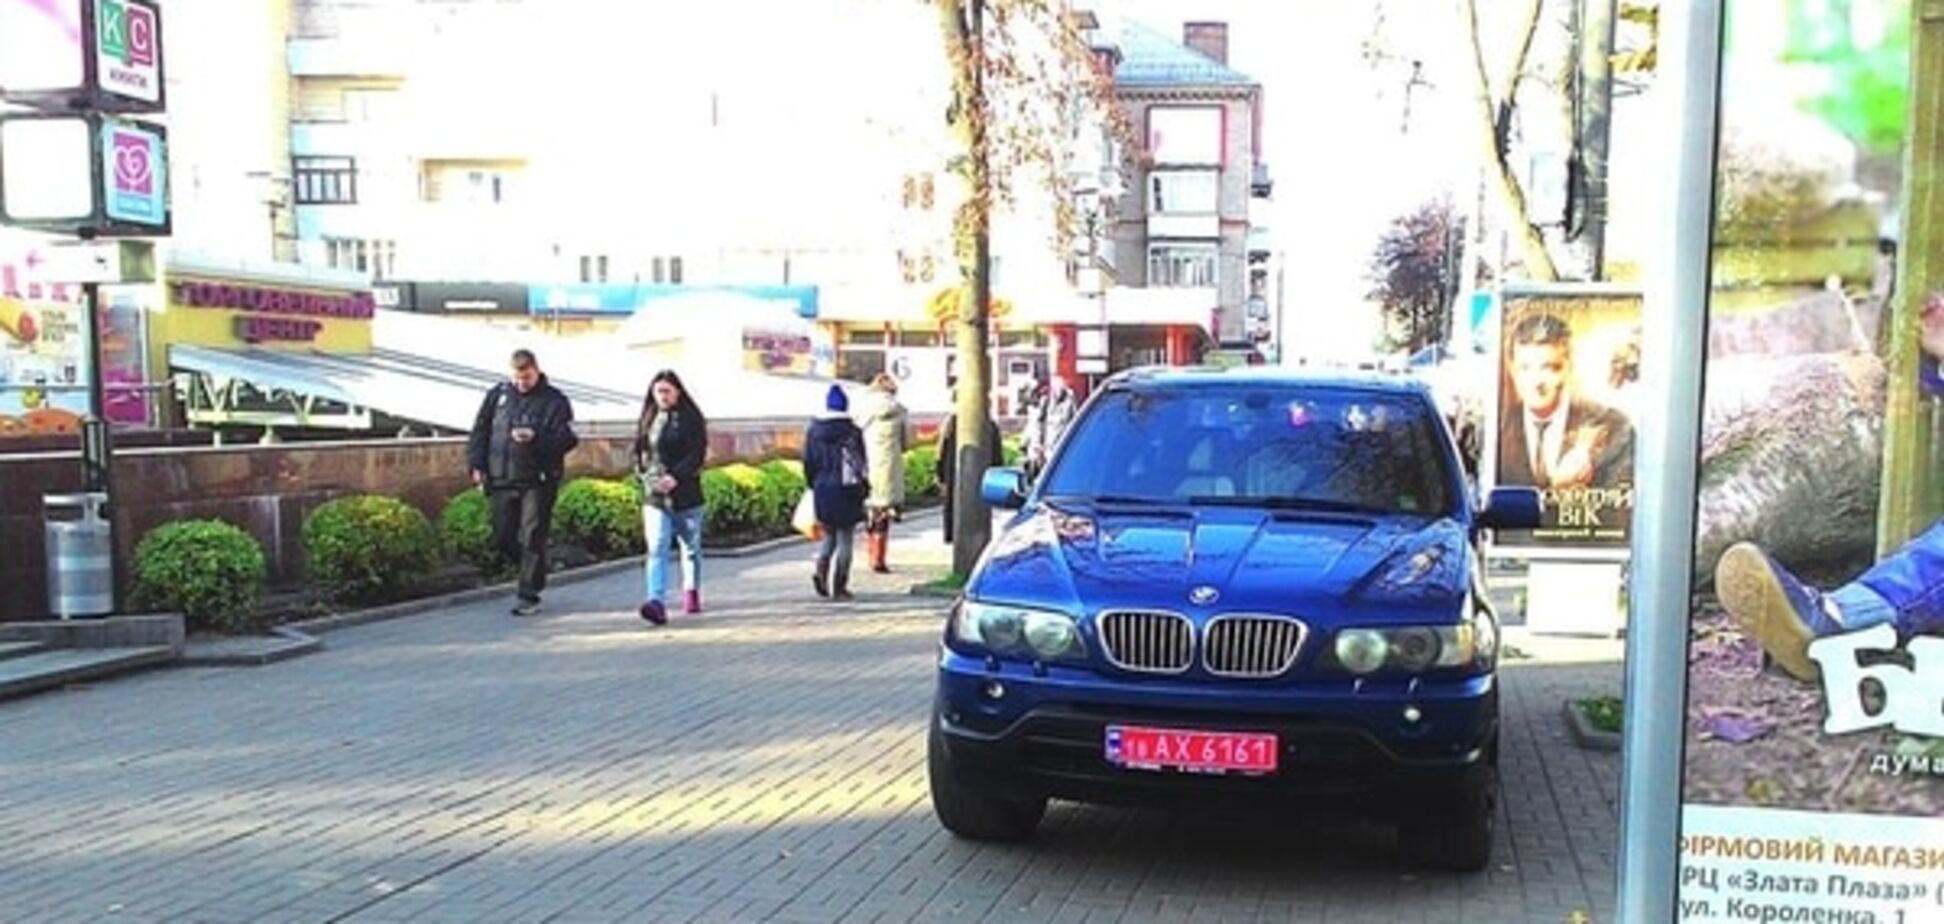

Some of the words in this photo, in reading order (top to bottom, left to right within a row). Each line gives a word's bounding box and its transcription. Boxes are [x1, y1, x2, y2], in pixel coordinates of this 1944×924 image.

[1202, 738, 1266, 763] 6161
[1727, 869, 1819, 894] «Злата
[1827, 874, 1927, 900] Плаза»
